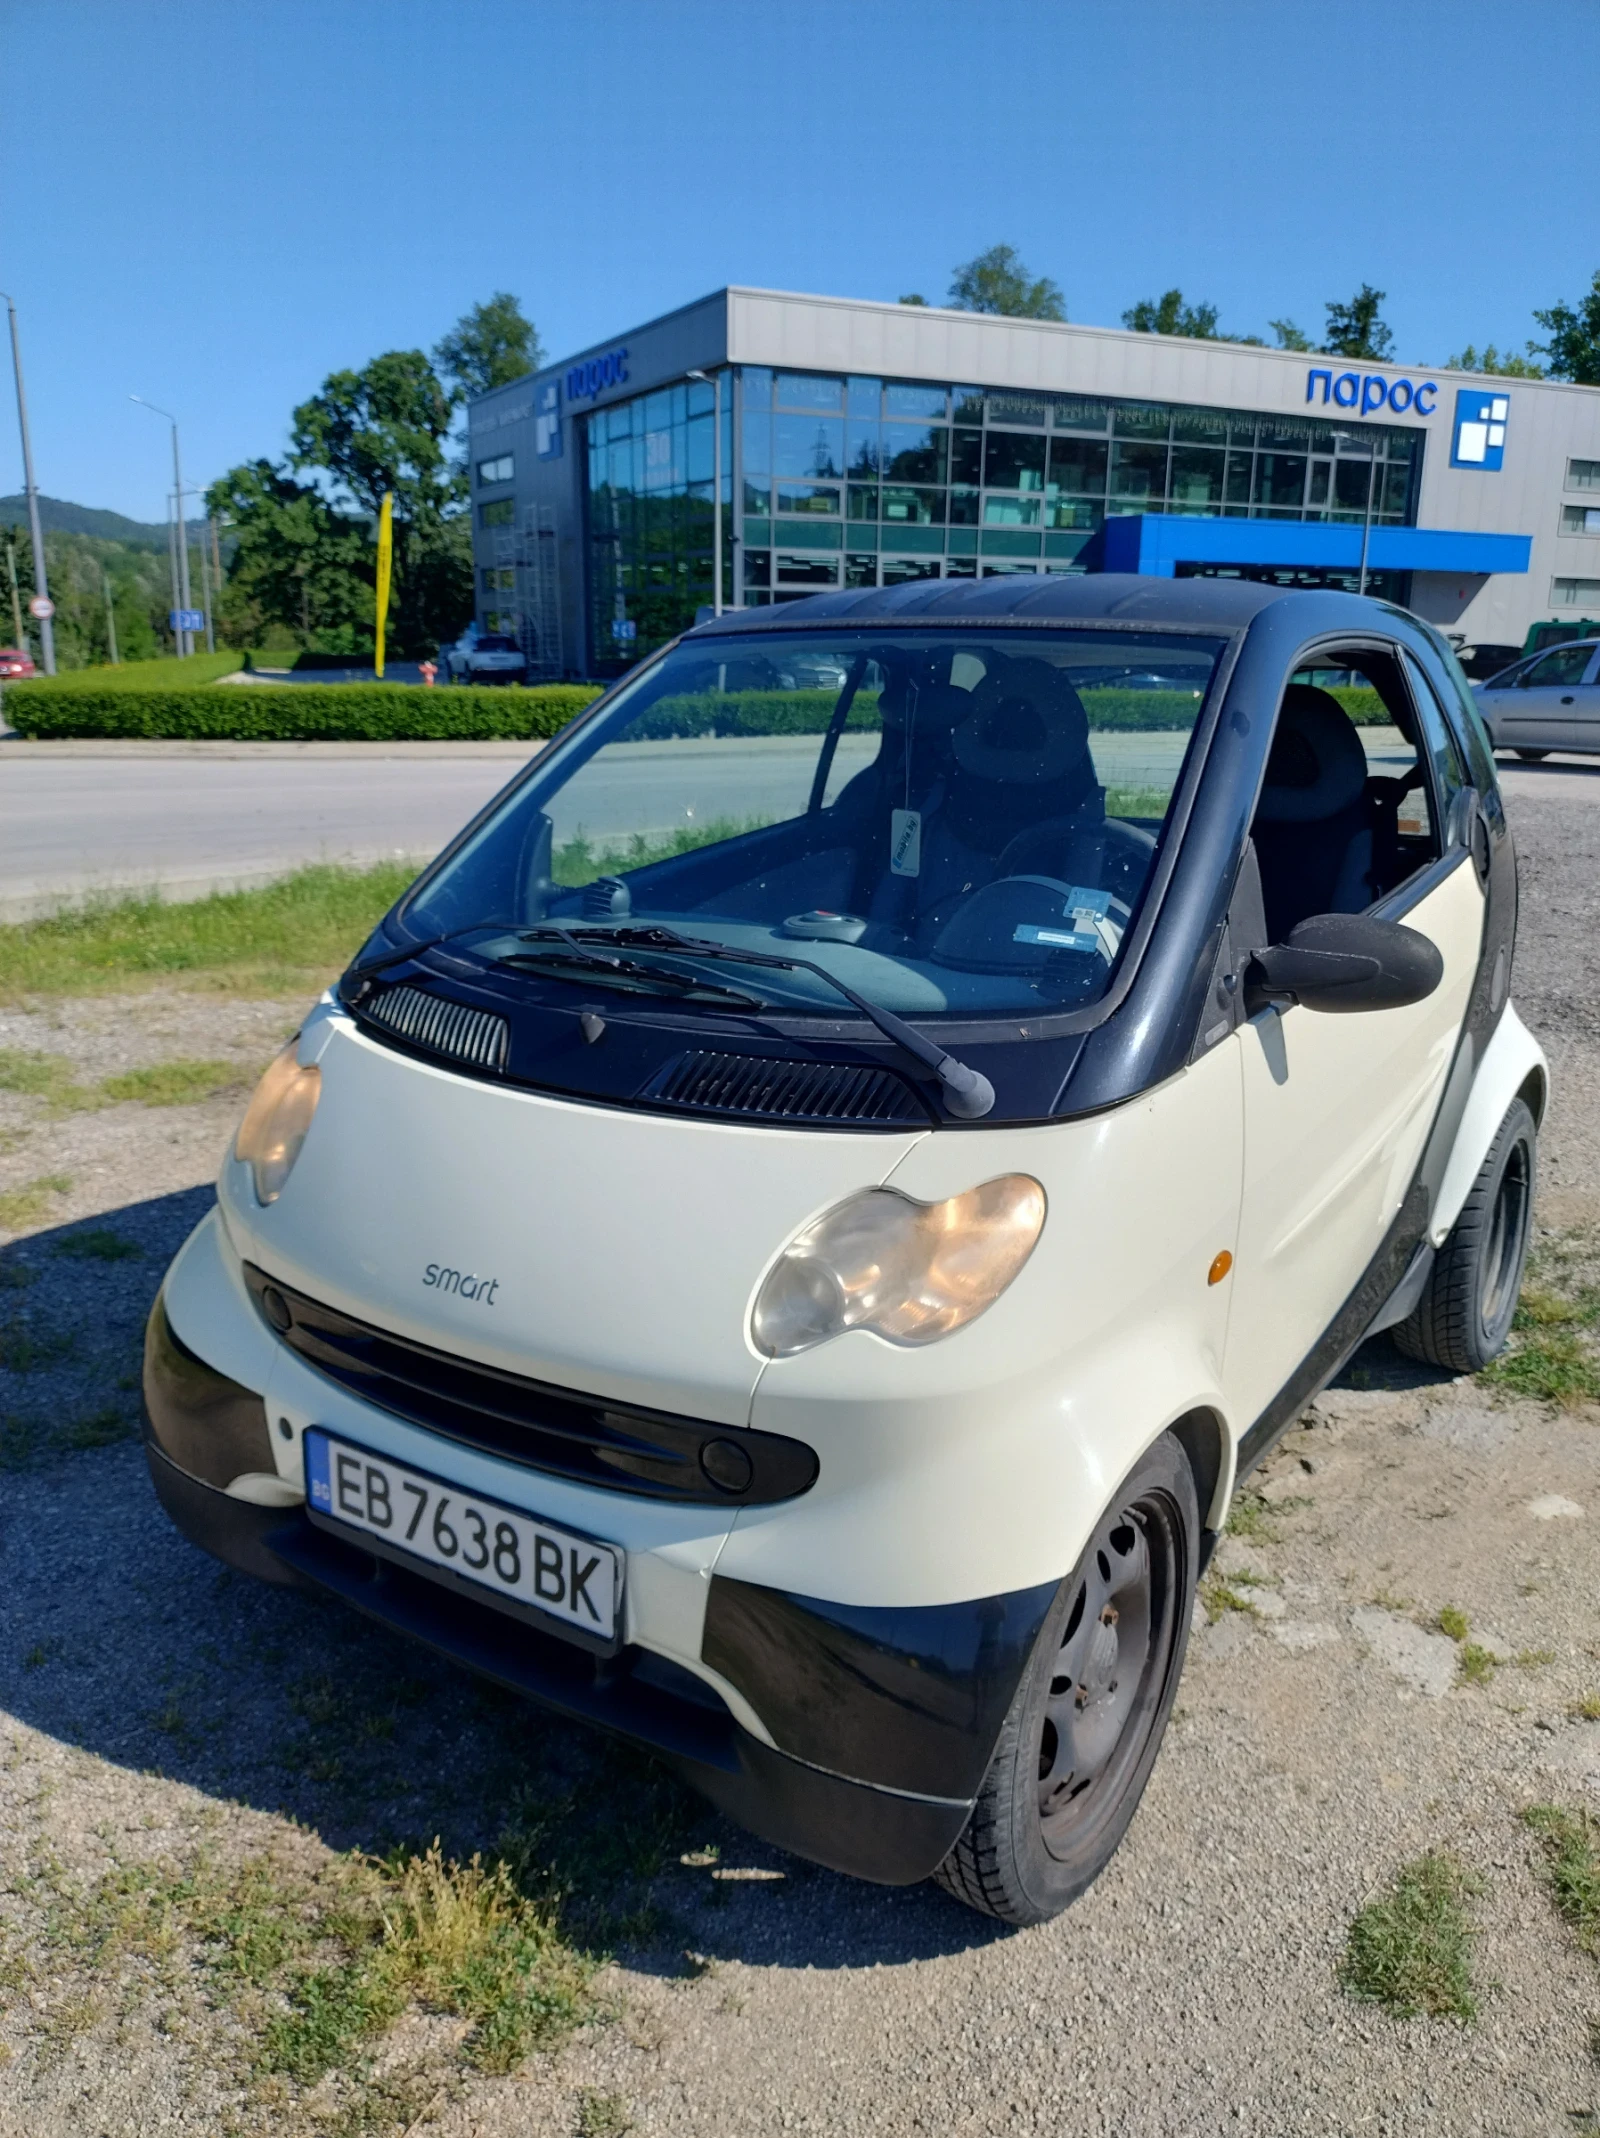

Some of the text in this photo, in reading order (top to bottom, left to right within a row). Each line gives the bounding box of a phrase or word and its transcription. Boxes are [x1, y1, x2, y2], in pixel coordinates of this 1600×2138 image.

[1307, 369, 1438, 416] парос
[896, 820, 917, 861] mobile.bg
[422, 1263, 499, 1306] smart
[311, 1479, 330, 1501] BG
[403, 1480, 522, 1584] 7638
